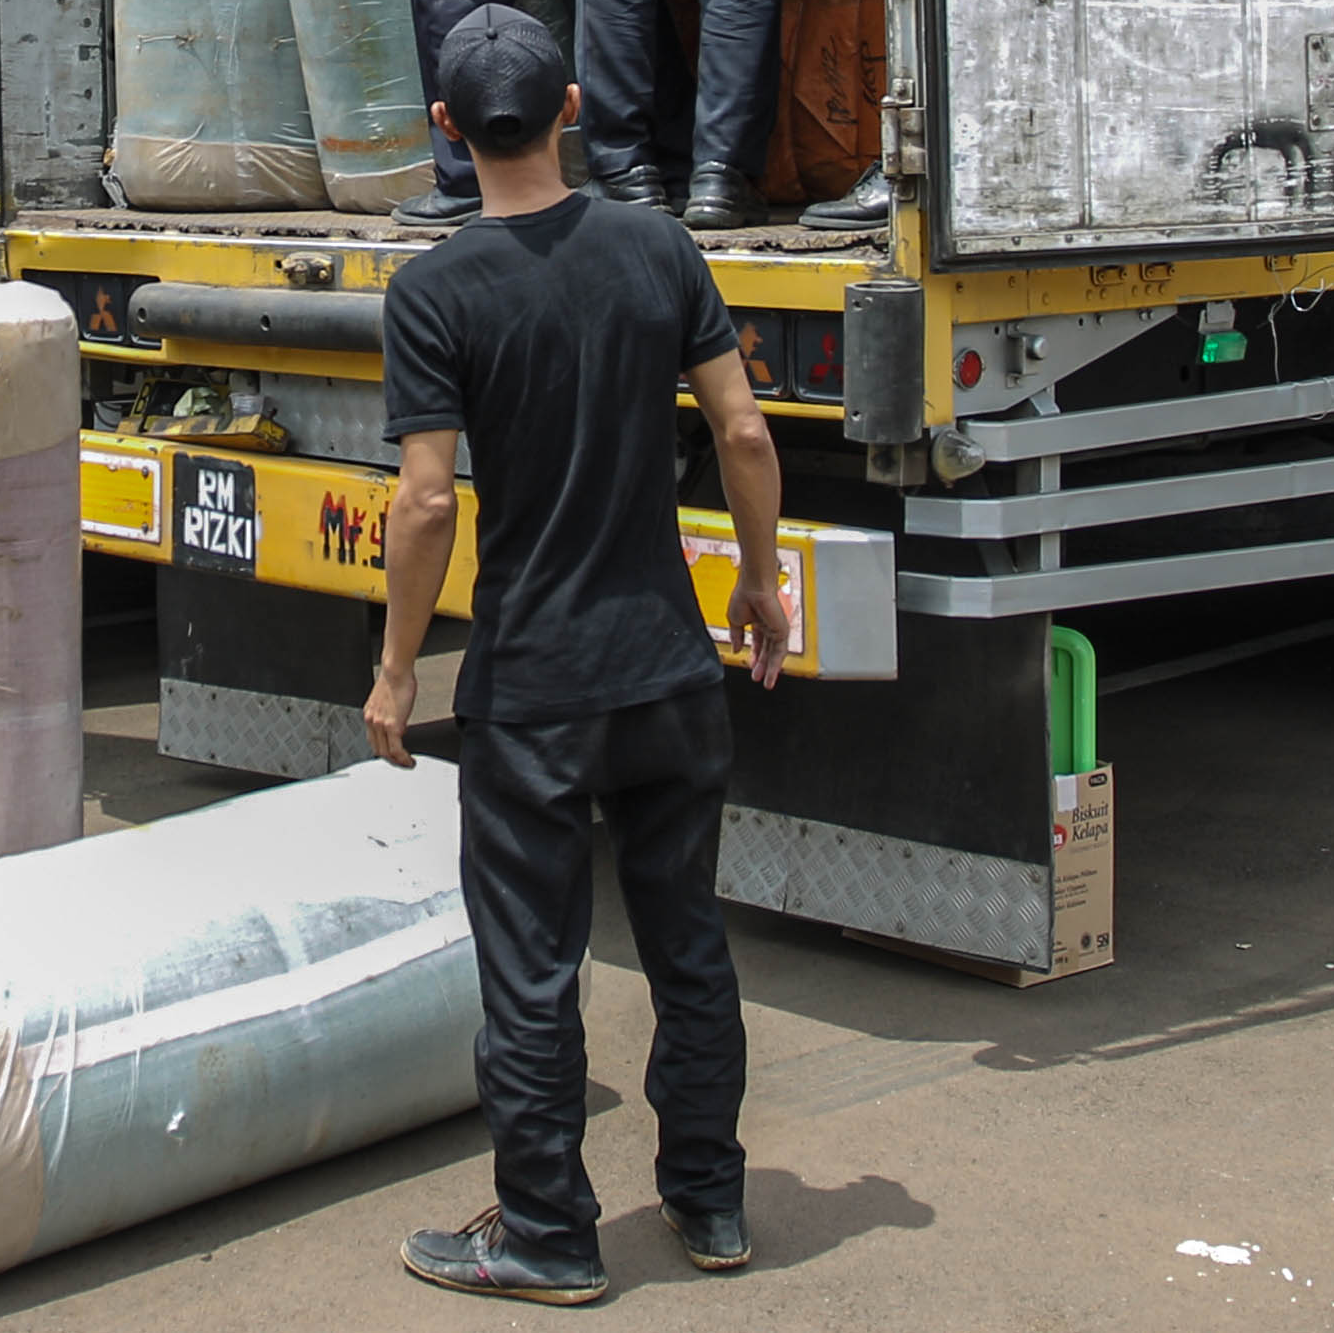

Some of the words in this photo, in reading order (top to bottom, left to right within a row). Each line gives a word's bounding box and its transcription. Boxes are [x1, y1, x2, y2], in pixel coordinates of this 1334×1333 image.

[197, 468, 237, 513] RM
[183, 506, 253, 560] RIZKI
[1072, 800, 1108, 824] Biskuit
[1072, 822, 1108, 842] Kelapa
